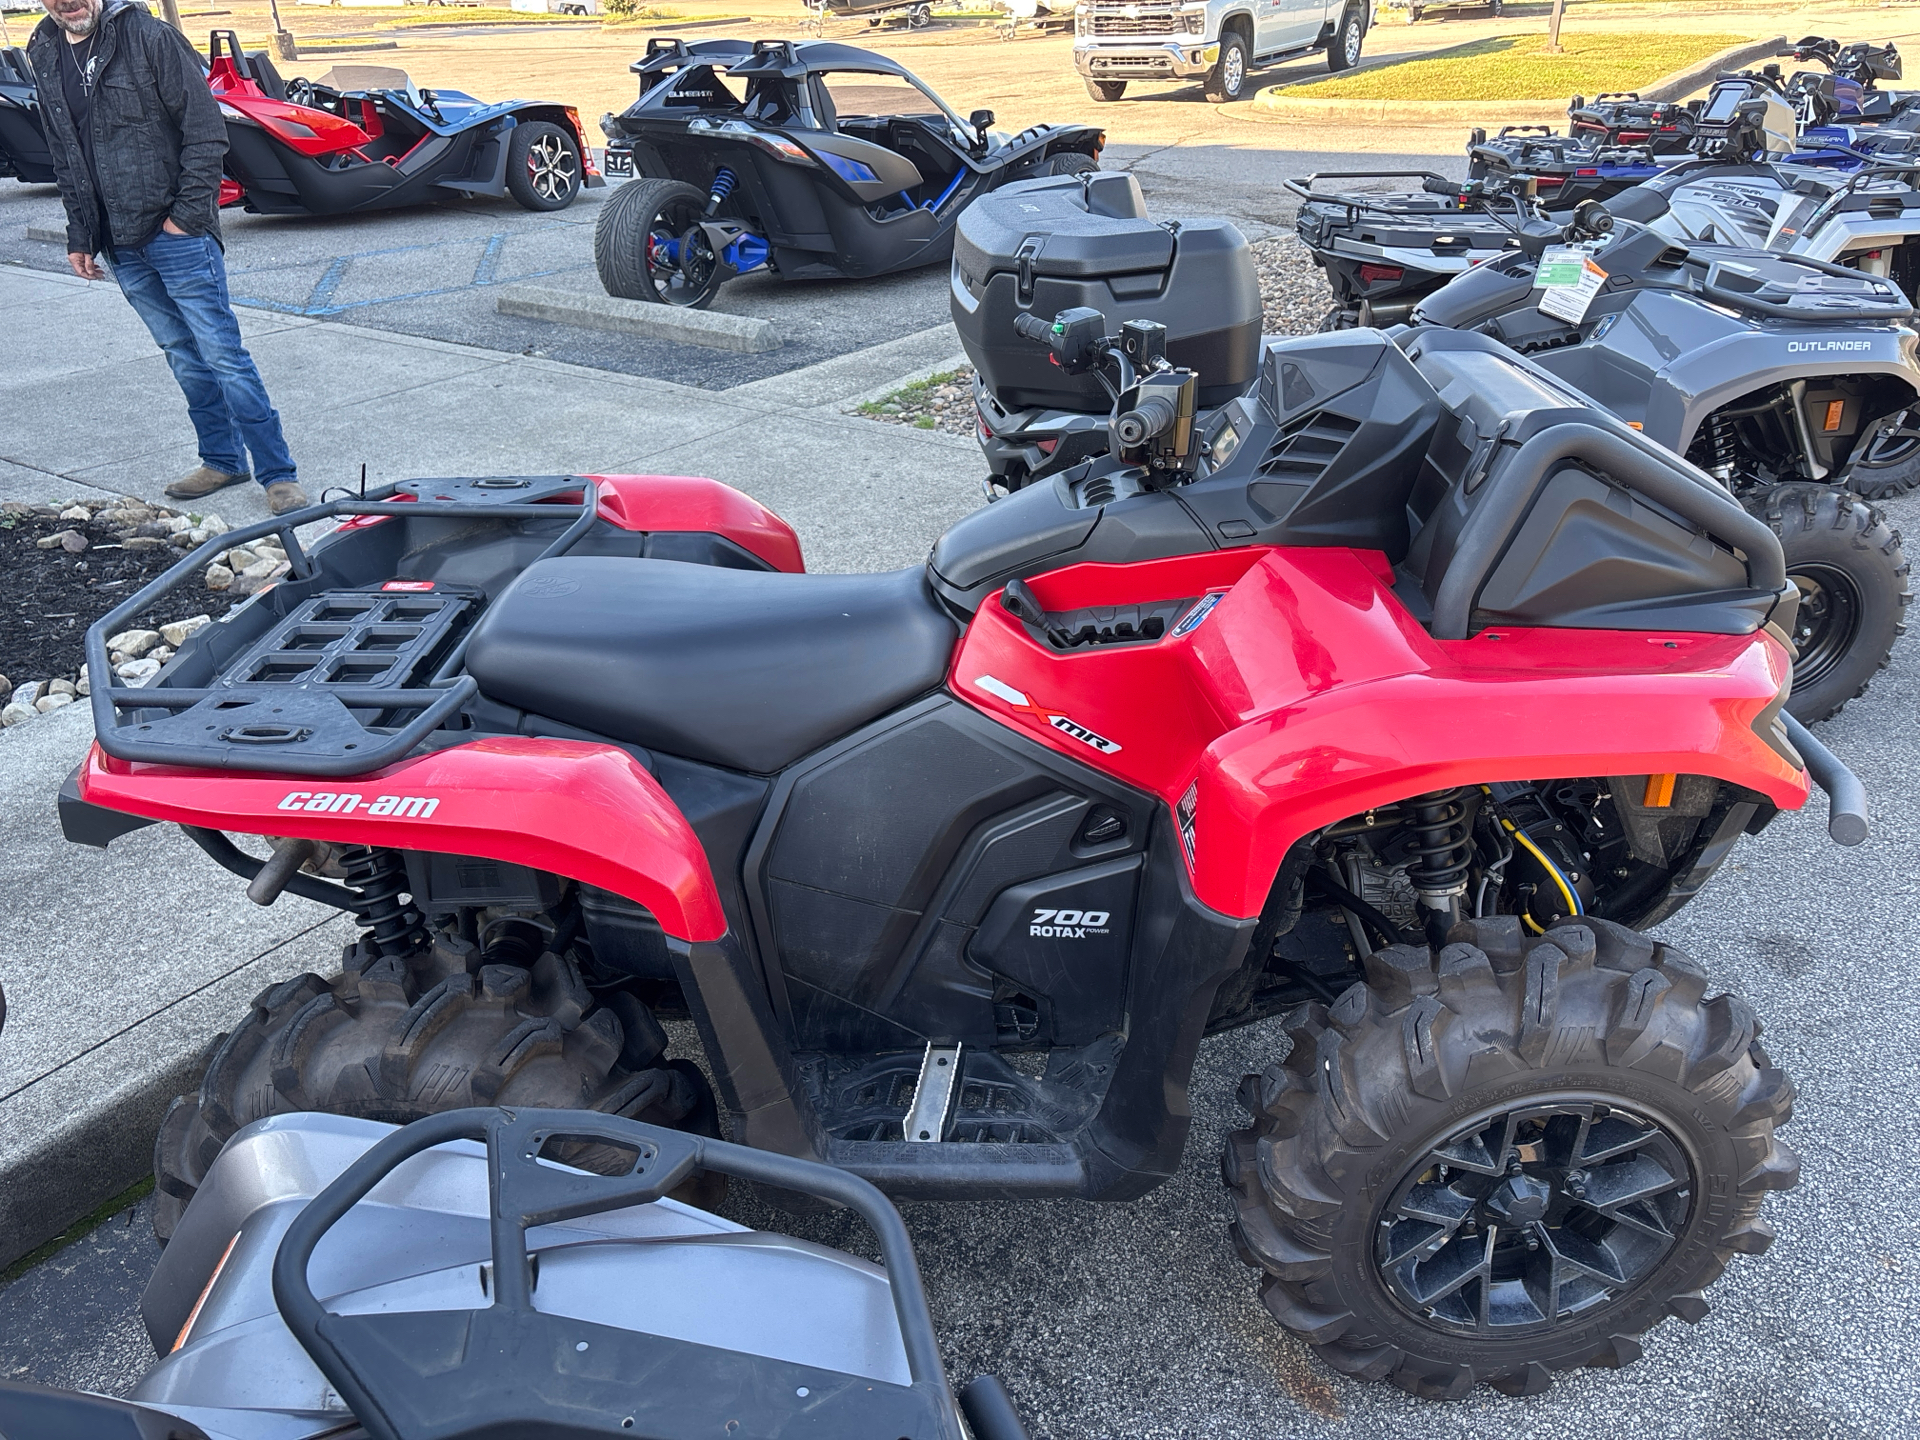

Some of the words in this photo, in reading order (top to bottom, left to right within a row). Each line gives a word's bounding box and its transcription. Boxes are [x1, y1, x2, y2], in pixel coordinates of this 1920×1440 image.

[1711, 182, 1765, 196] SPORTSMAN
[1710, 194, 1760, 208] 570
[1787, 341, 1871, 352] OUTLANDER
[277, 791, 441, 819] can-am
[1030, 908, 1110, 927] 700
[1029, 925, 1086, 939] ROTAX
